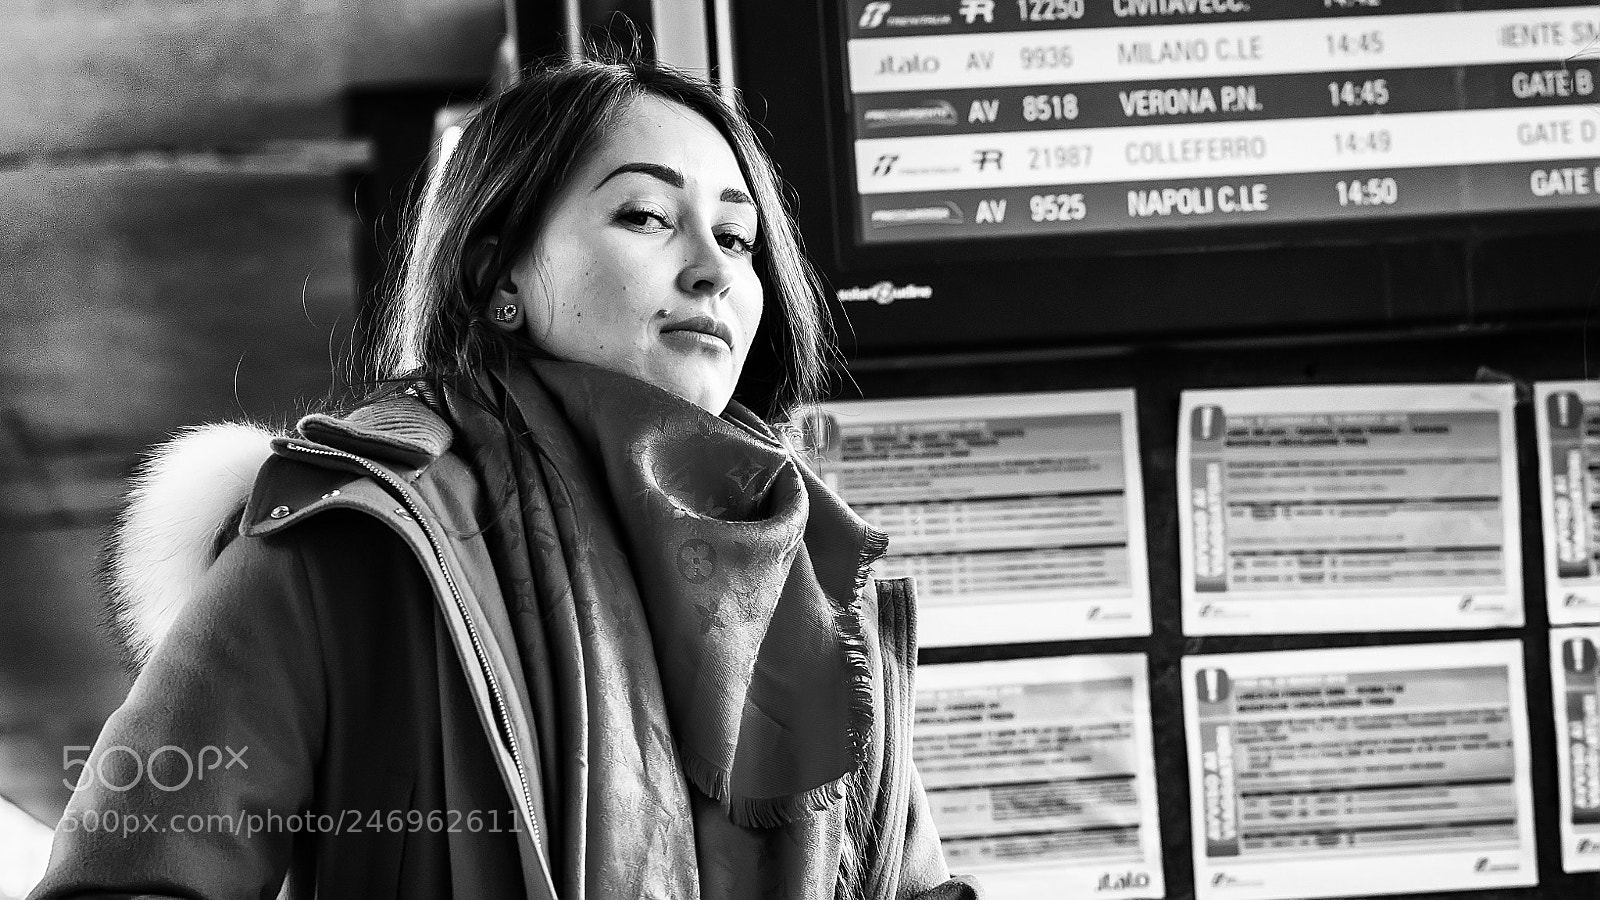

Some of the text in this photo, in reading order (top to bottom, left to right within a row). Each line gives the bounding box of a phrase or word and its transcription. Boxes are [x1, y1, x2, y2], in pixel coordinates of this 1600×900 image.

[1018, 0, 1085, 22] 12250
[965, 51, 995, 71] AV
[1019, 46, 1074, 70] 9936
[1117, 38, 1209, 65] MILANO
[1326, 30, 1385, 56] 14:45
[968, 100, 1000, 123] AV
[1022, 93, 1079, 122] 8518
[1119, 87, 1218, 117] VERONA
[1328, 79, 1390, 107] 14:45
[1511, 69, 1572, 98] GATE
[1574, 68, 1595, 96] B
[1028, 145, 1093, 170] 21987
[1125, 135, 1267, 165] COLLEFERRO
[1334, 129, 1393, 153] 14:49
[1517, 121, 1571, 146] GATE
[975, 200, 1007, 224] AV
[1029, 193, 1087, 222] 9525
[1127, 186, 1215, 217] NAPOLI
[1217, 183, 1270, 212] C.LE
[1335, 177, 1399, 206] 14:50
[1530, 167, 1592, 197] GATE
